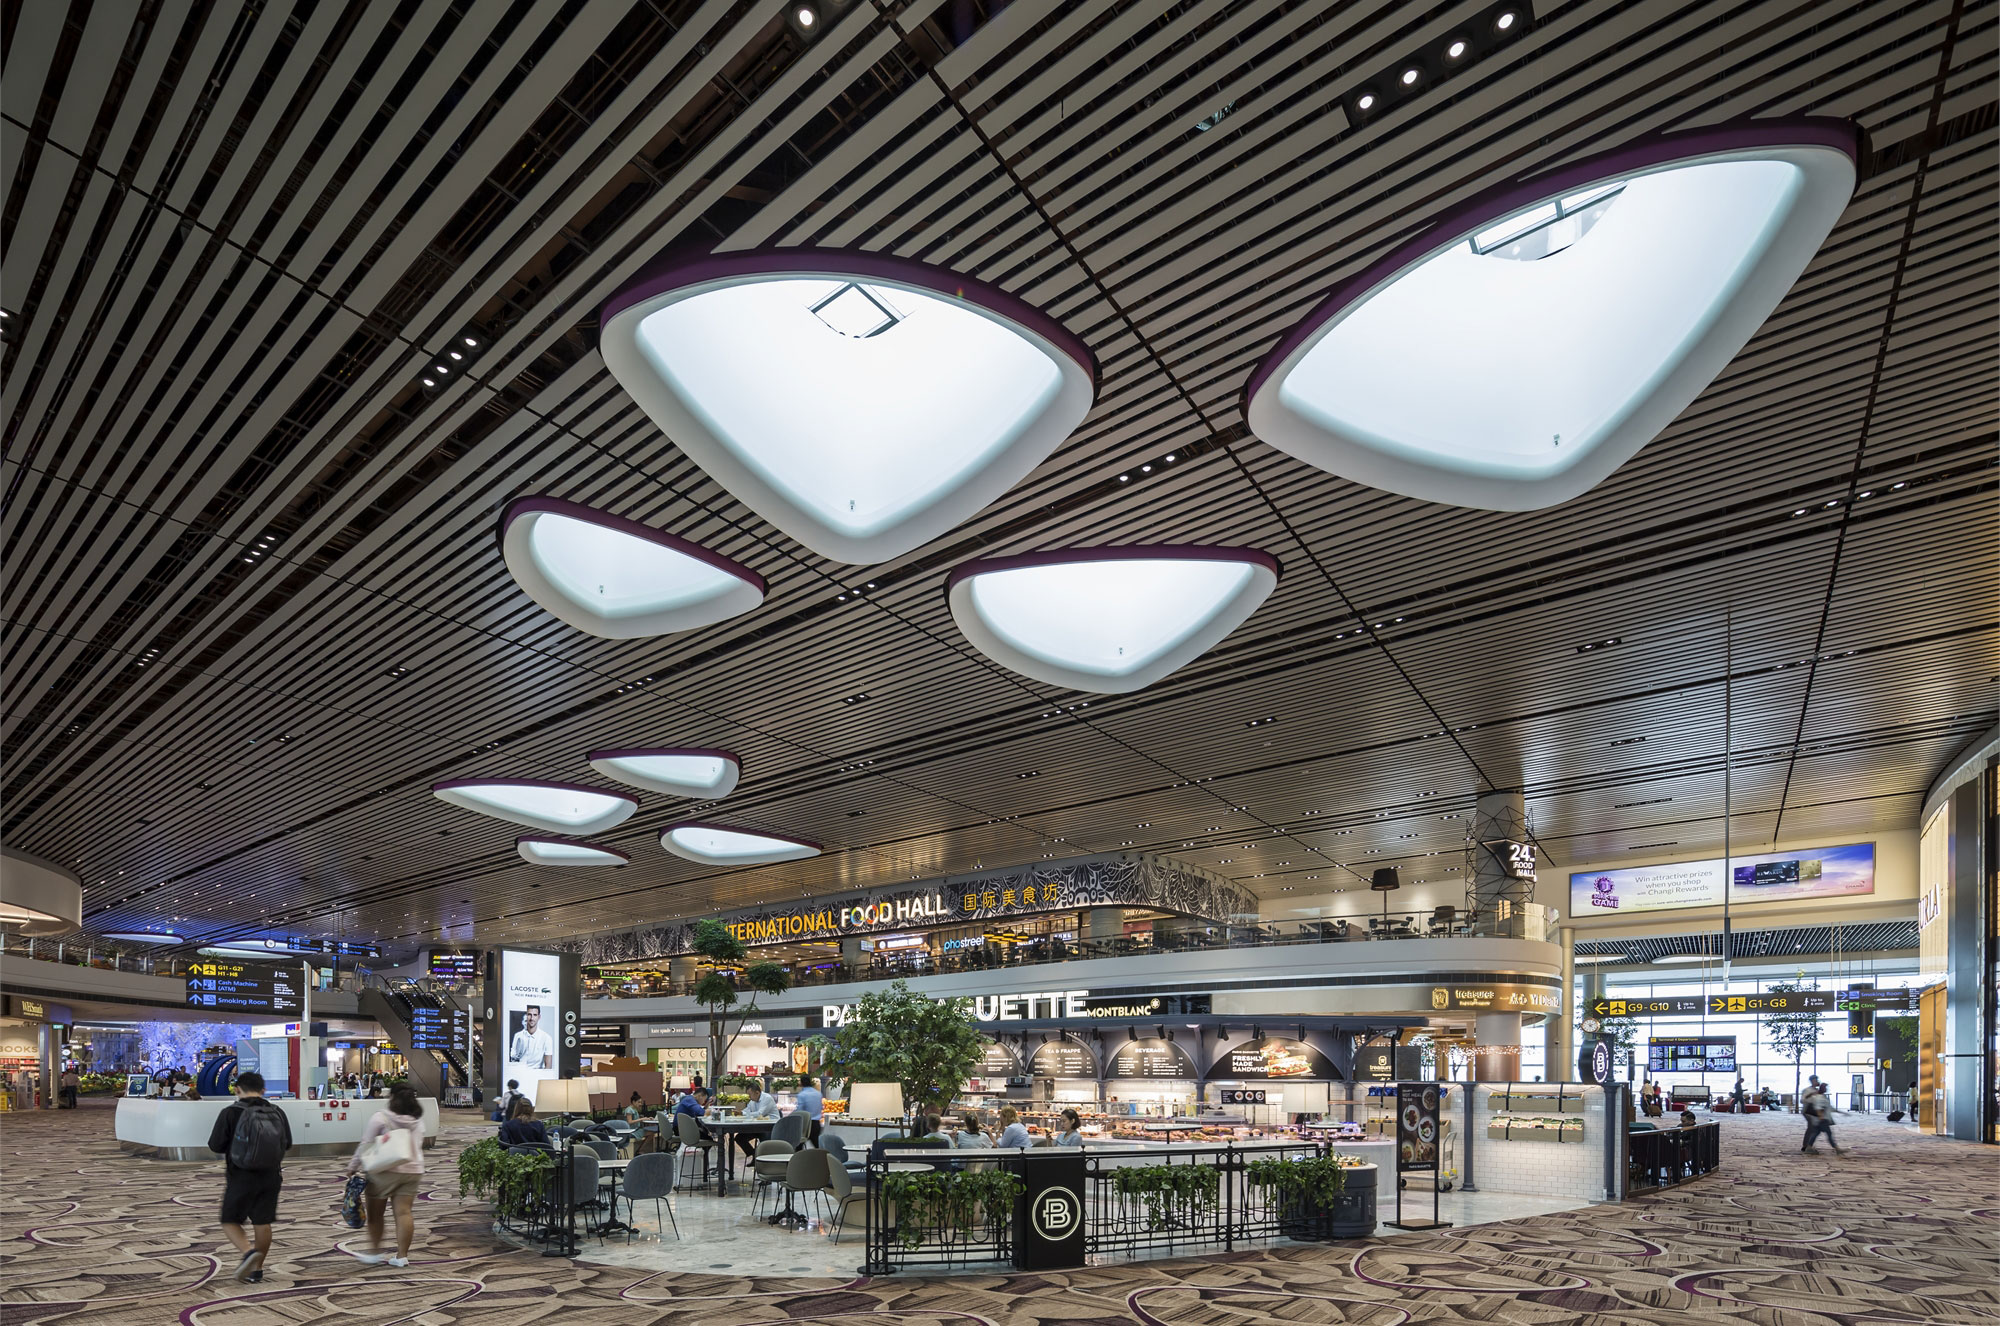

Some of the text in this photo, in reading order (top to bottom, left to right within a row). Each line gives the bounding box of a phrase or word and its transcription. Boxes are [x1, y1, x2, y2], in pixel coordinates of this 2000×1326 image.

[1509, 844, 1530, 861] 24
[1516, 869, 1536, 877] HALL
[1652, 872, 1688, 882] attractive
[1690, 870, 1713, 880] prizes
[1668, 880, 1681, 888] you
[1682, 878, 1702, 887] shop
[1648, 887, 1674, 896] Changi
[1676, 884, 1709, 894] Rewards
[964, 884, 1058, 912] 国际美食坊
[1592, 900, 1620, 908] GAME
[1918, 883, 1940, 933] URLA
[725, 894, 948, 941] TERNATIONAL FOOD HALL
[944, 935, 985, 952] phostreet
[218, 998, 247, 1006] Smoking
[1628, 1003, 1642, 1012] G9
[1650, 1002, 1670, 1011] G10
[1748, 999, 1763, 1008] G1
[1770, 998, 1787, 1008] G8
[1086, 1005, 1152, 1018] MONTBLANC
